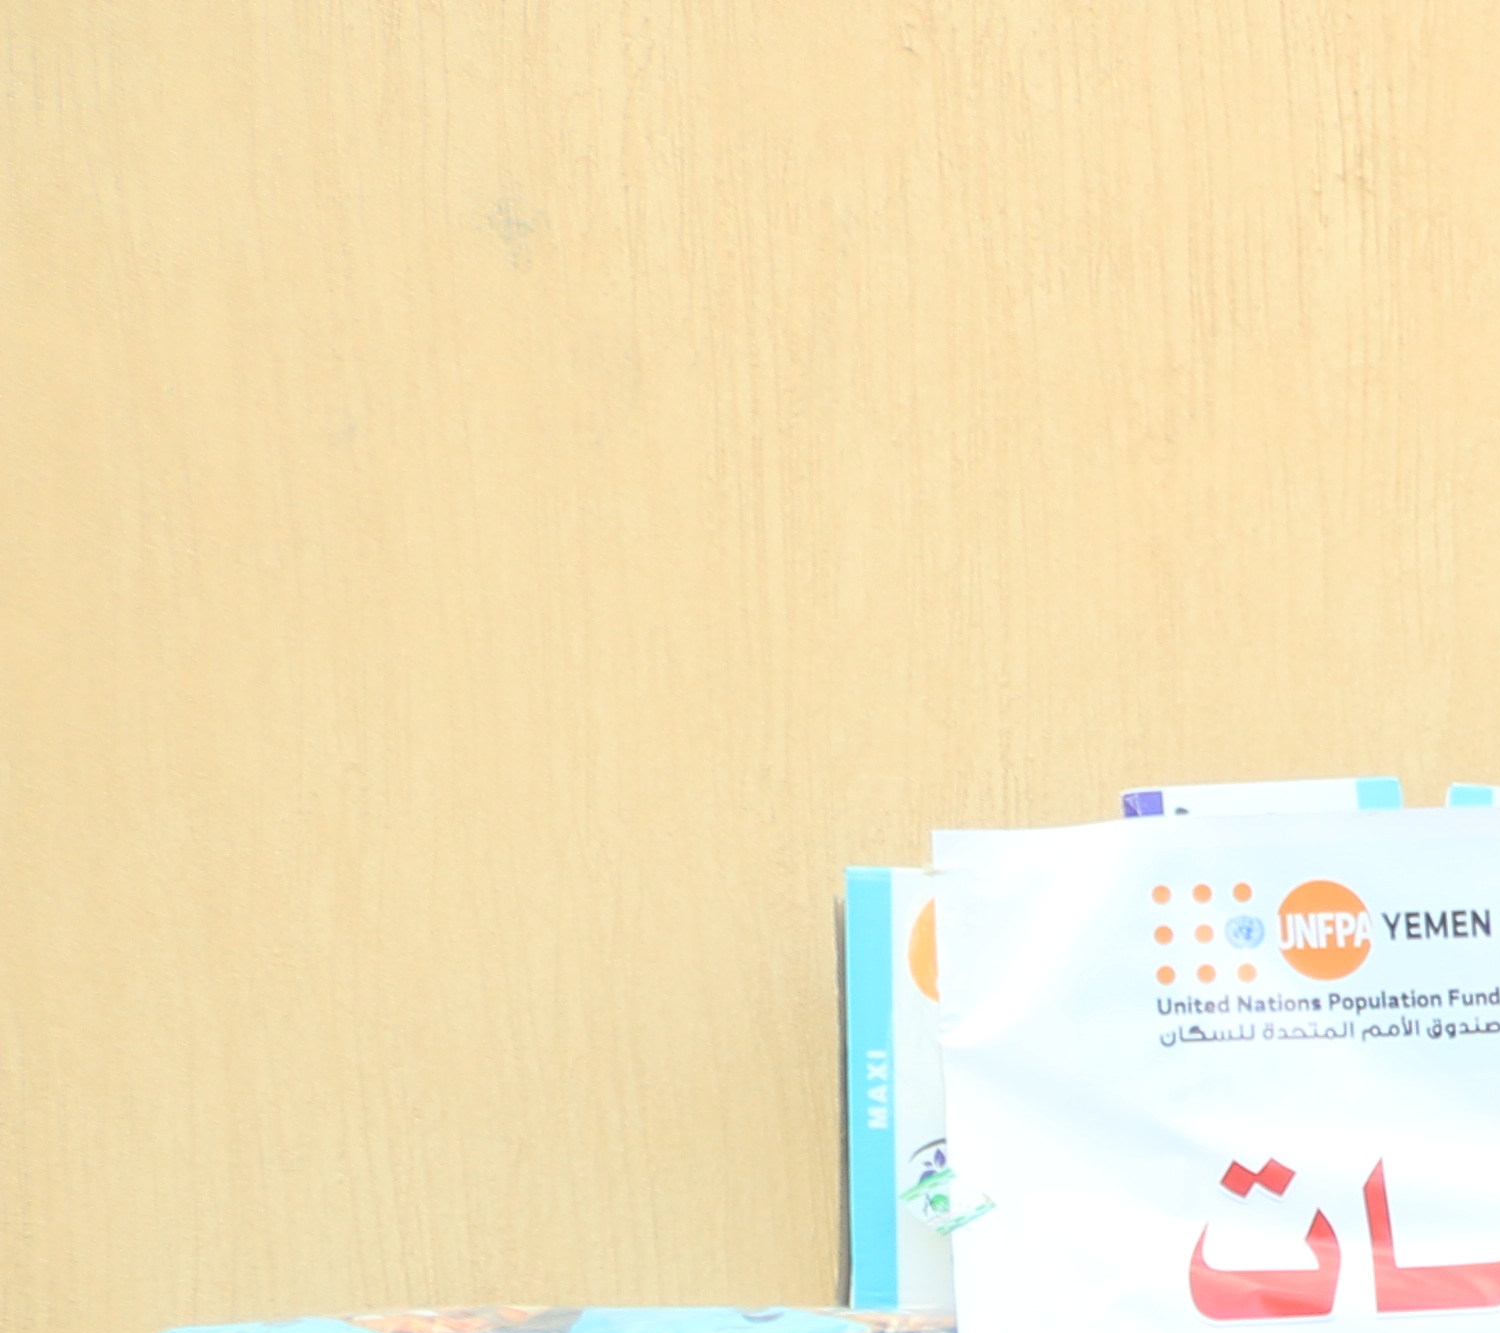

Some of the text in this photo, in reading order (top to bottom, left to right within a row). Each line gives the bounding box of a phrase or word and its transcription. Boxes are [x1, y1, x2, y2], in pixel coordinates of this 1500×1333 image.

[1277, 909, 1493, 950] UNFPA YEMEN
[1156, 985, 1500, 1017] United Nations Population Fund
[1158, 1022, 1256, 1048] للسكان
[1262, 1020, 1355, 1042] المتحدة
[1362, 1017, 1420, 1042] الأمم
[868, 1048, 887, 1129] MAXI
